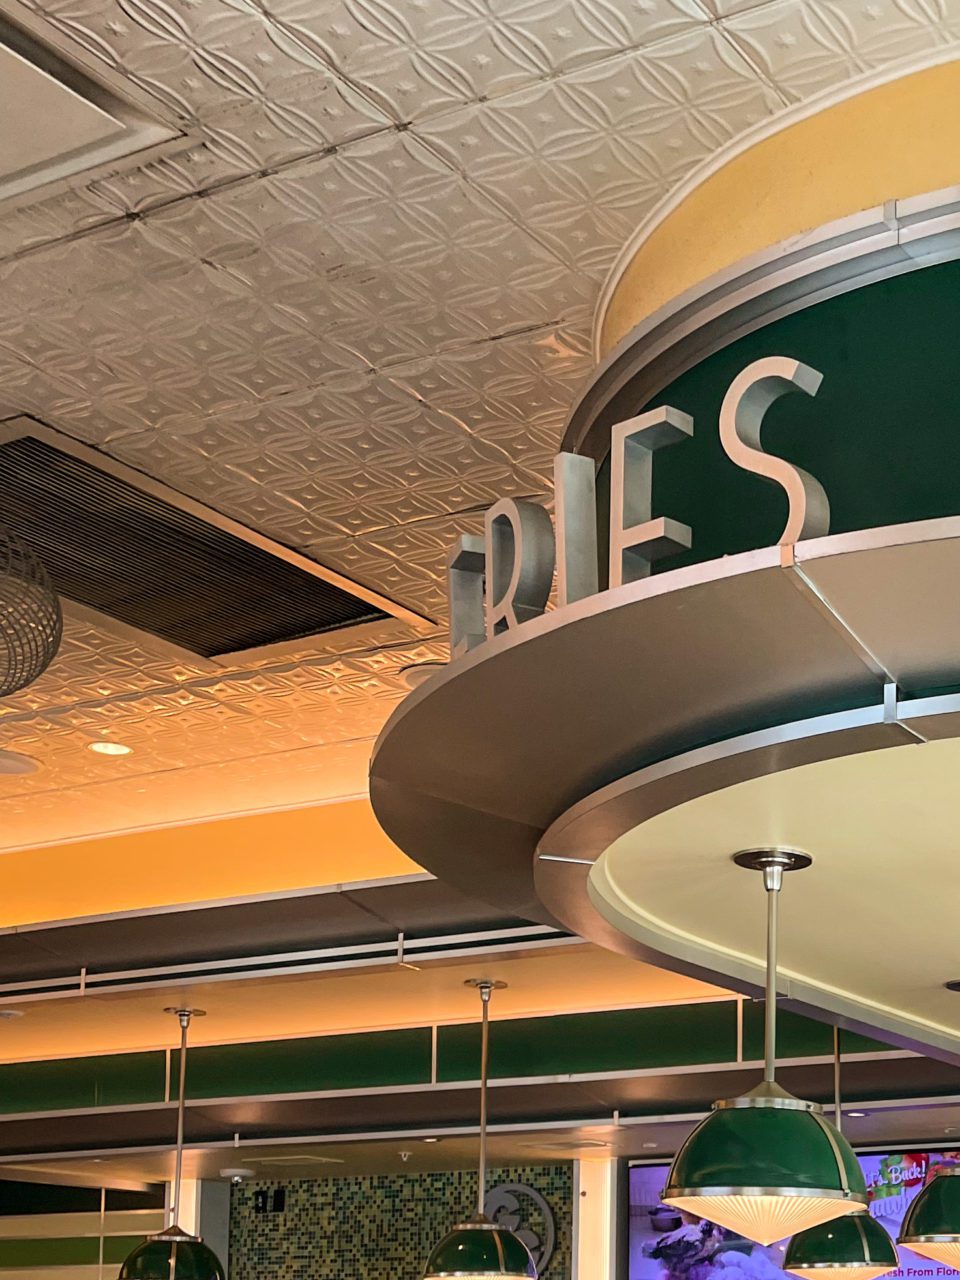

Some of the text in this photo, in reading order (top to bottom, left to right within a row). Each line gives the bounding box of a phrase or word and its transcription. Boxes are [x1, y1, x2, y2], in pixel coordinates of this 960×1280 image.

[887, 1160, 926, 1185] Back!
[882, 1267, 904, 1278] resh
[906, 1267, 934, 1277] From
